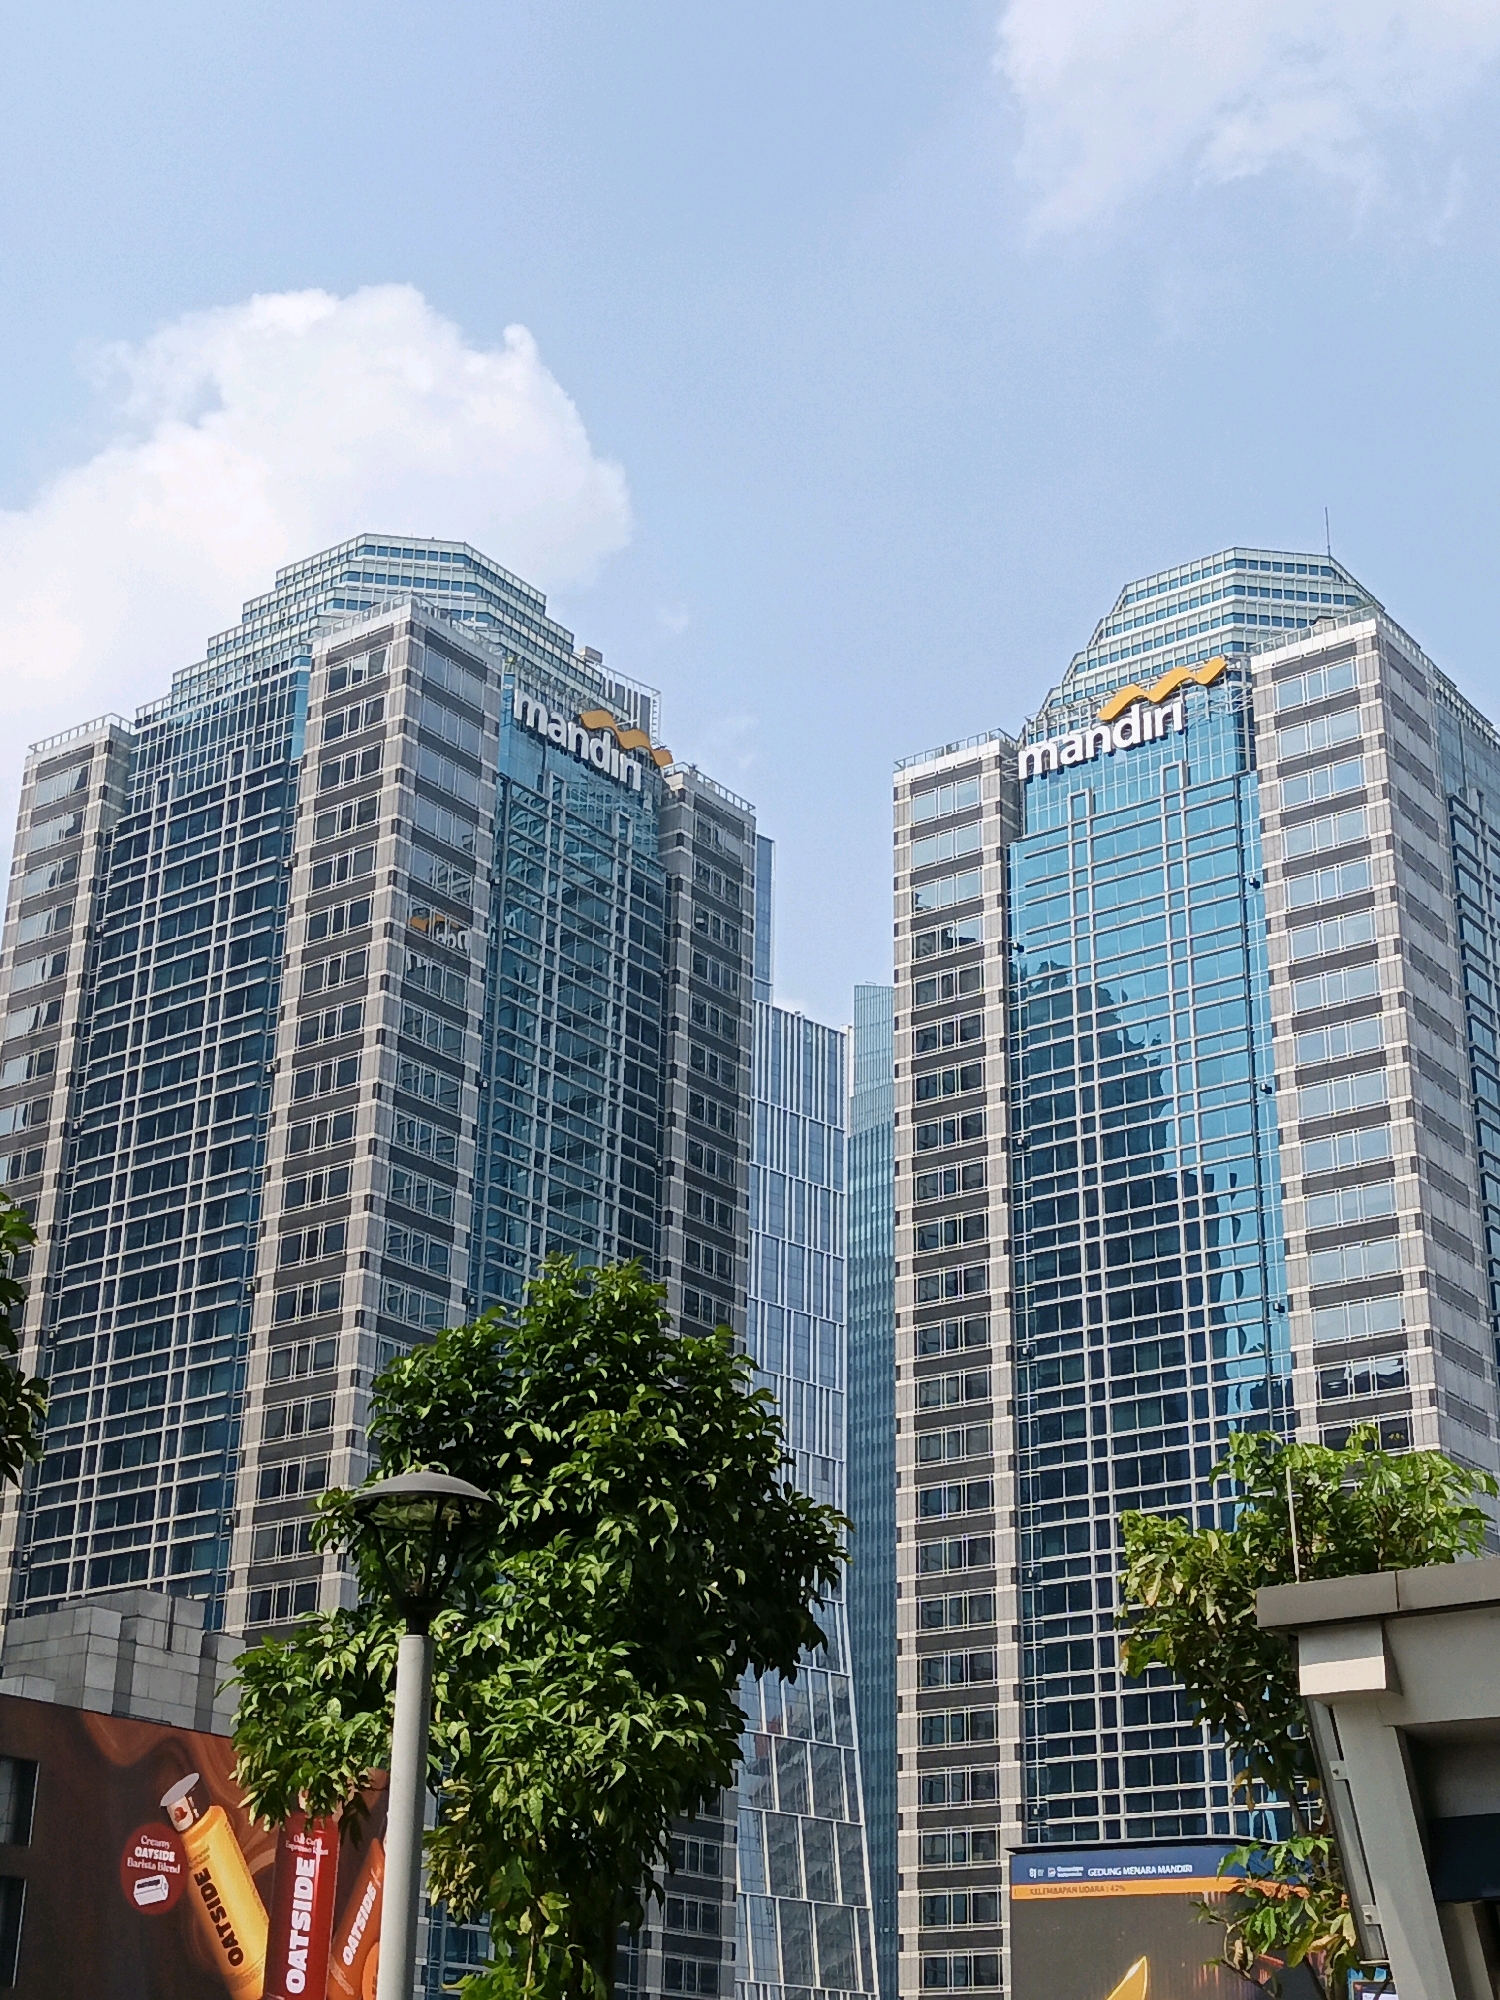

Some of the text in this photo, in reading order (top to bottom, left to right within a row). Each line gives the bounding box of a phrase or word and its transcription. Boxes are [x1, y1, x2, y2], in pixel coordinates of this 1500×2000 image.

[513, 688, 642, 792] mandiri
[1018, 700, 1184, 780] mandiri
[134, 1846, 176, 1862] OATSIDE
[1087, 1867, 1122, 1877] GEDUNG
[1122, 1865, 1156, 1876] MENARA
[1157, 1864, 1193, 1874] MANDIRI
[193, 1867, 244, 1967] OATSIDE
[286, 1856, 316, 1994] OATSIDE
[342, 1880, 377, 1966] OATSIDE
